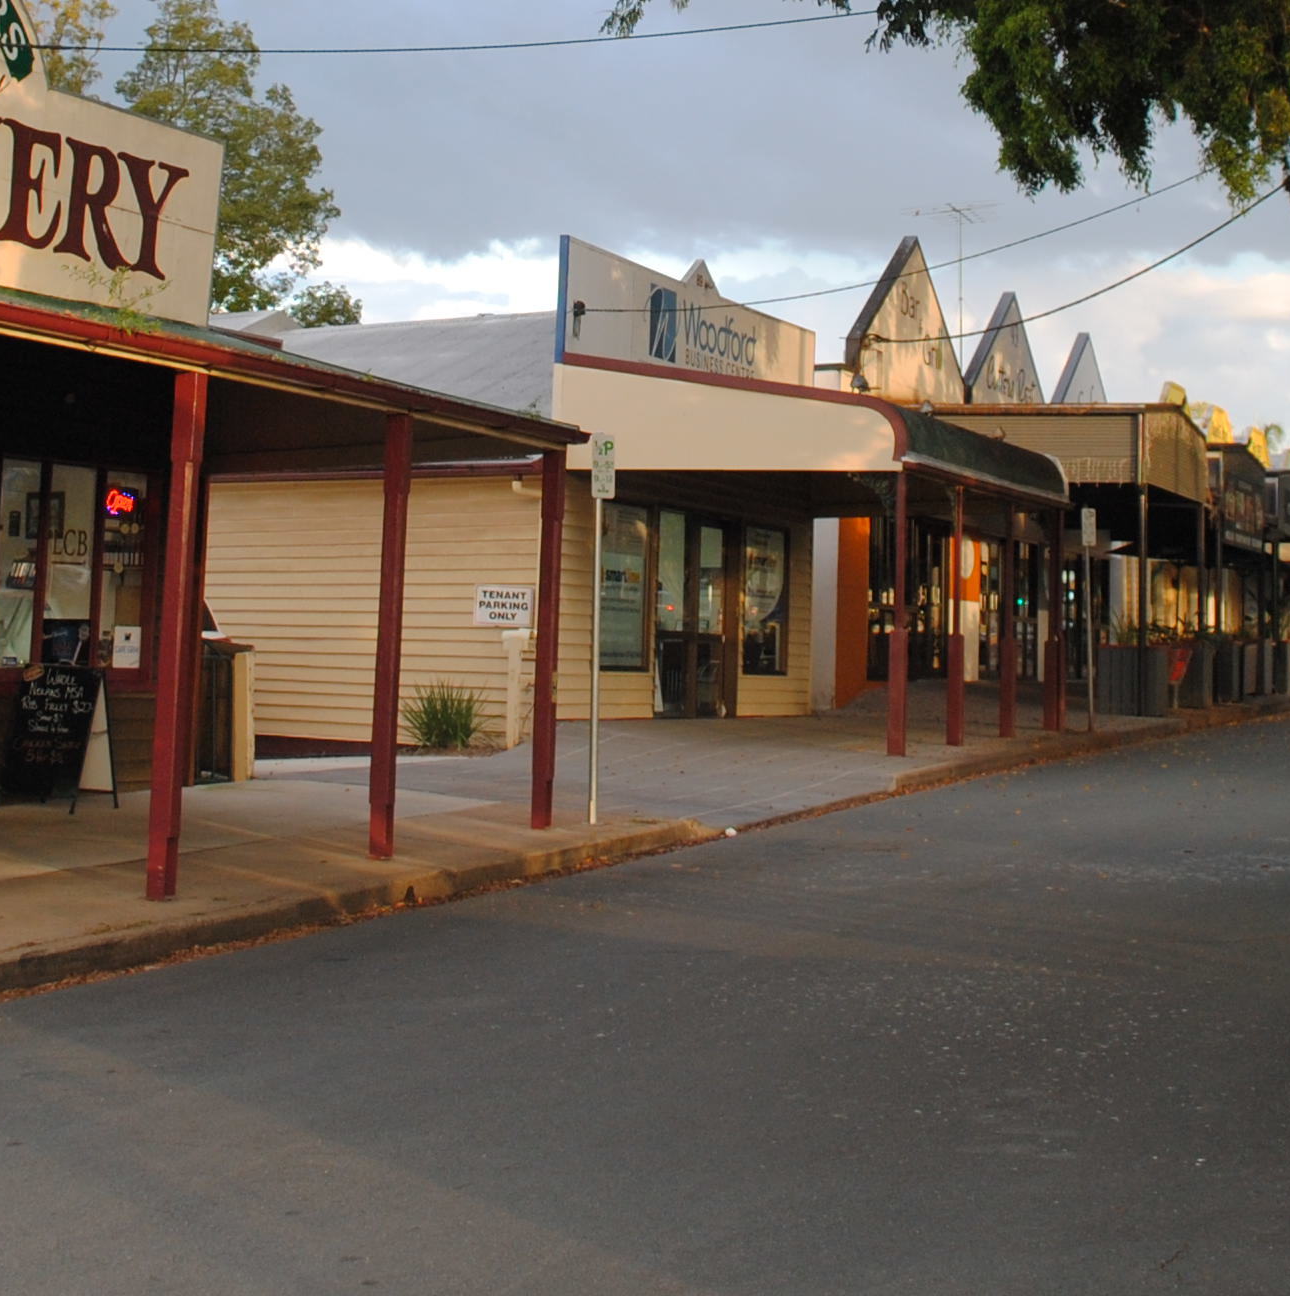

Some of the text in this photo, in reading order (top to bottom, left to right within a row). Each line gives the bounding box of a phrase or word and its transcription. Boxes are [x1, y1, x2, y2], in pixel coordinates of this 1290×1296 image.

[683, 299, 758, 367] Woodford
[52, 529, 89, 558] LCB
[482, 590, 527, 600] TENANT
[478, 600, 529, 611] PARKING
[489, 611, 517, 621] ONLY
